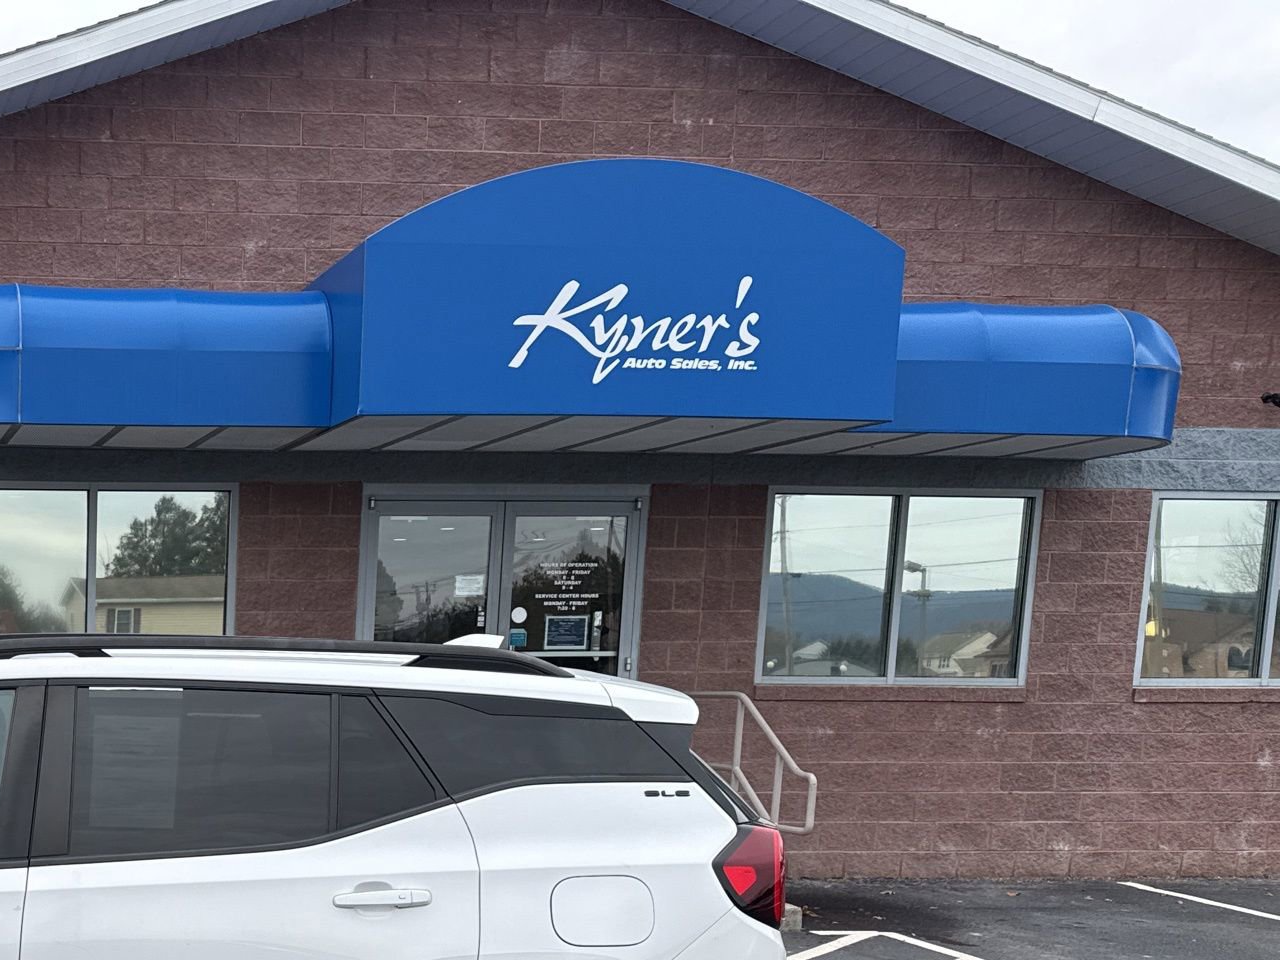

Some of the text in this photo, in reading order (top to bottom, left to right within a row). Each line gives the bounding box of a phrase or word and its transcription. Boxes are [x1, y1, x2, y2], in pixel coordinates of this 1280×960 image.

[508, 275, 760, 384] Kyner's
[622, 357, 758, 371] Auto Sales, Inc.
